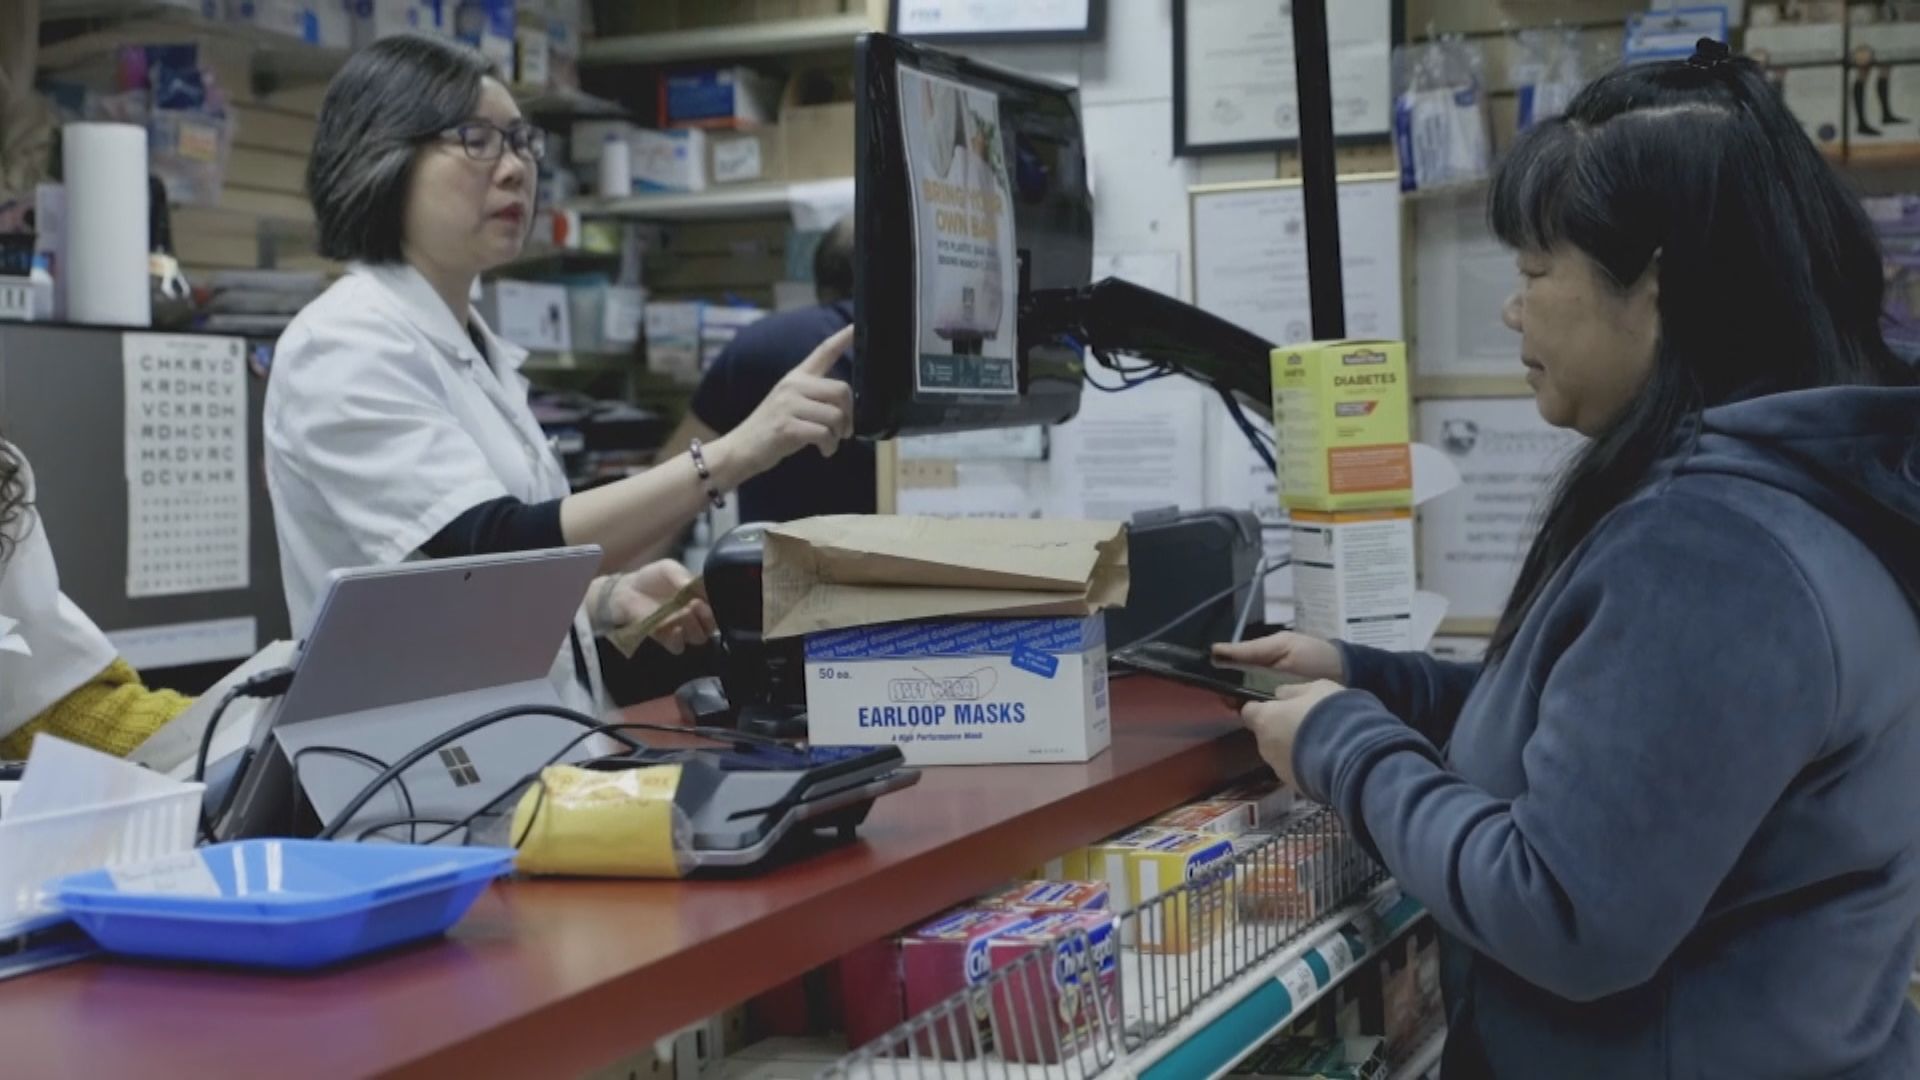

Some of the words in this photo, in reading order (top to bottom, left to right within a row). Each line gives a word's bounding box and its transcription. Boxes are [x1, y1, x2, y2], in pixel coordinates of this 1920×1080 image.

[936, 208, 967, 235] OWN
[1334, 372, 1397, 387] DIABETES
[819, 668, 835, 679] 50
[859, 705, 946, 728] EARLOOP
[954, 702, 1025, 725] MASKS
